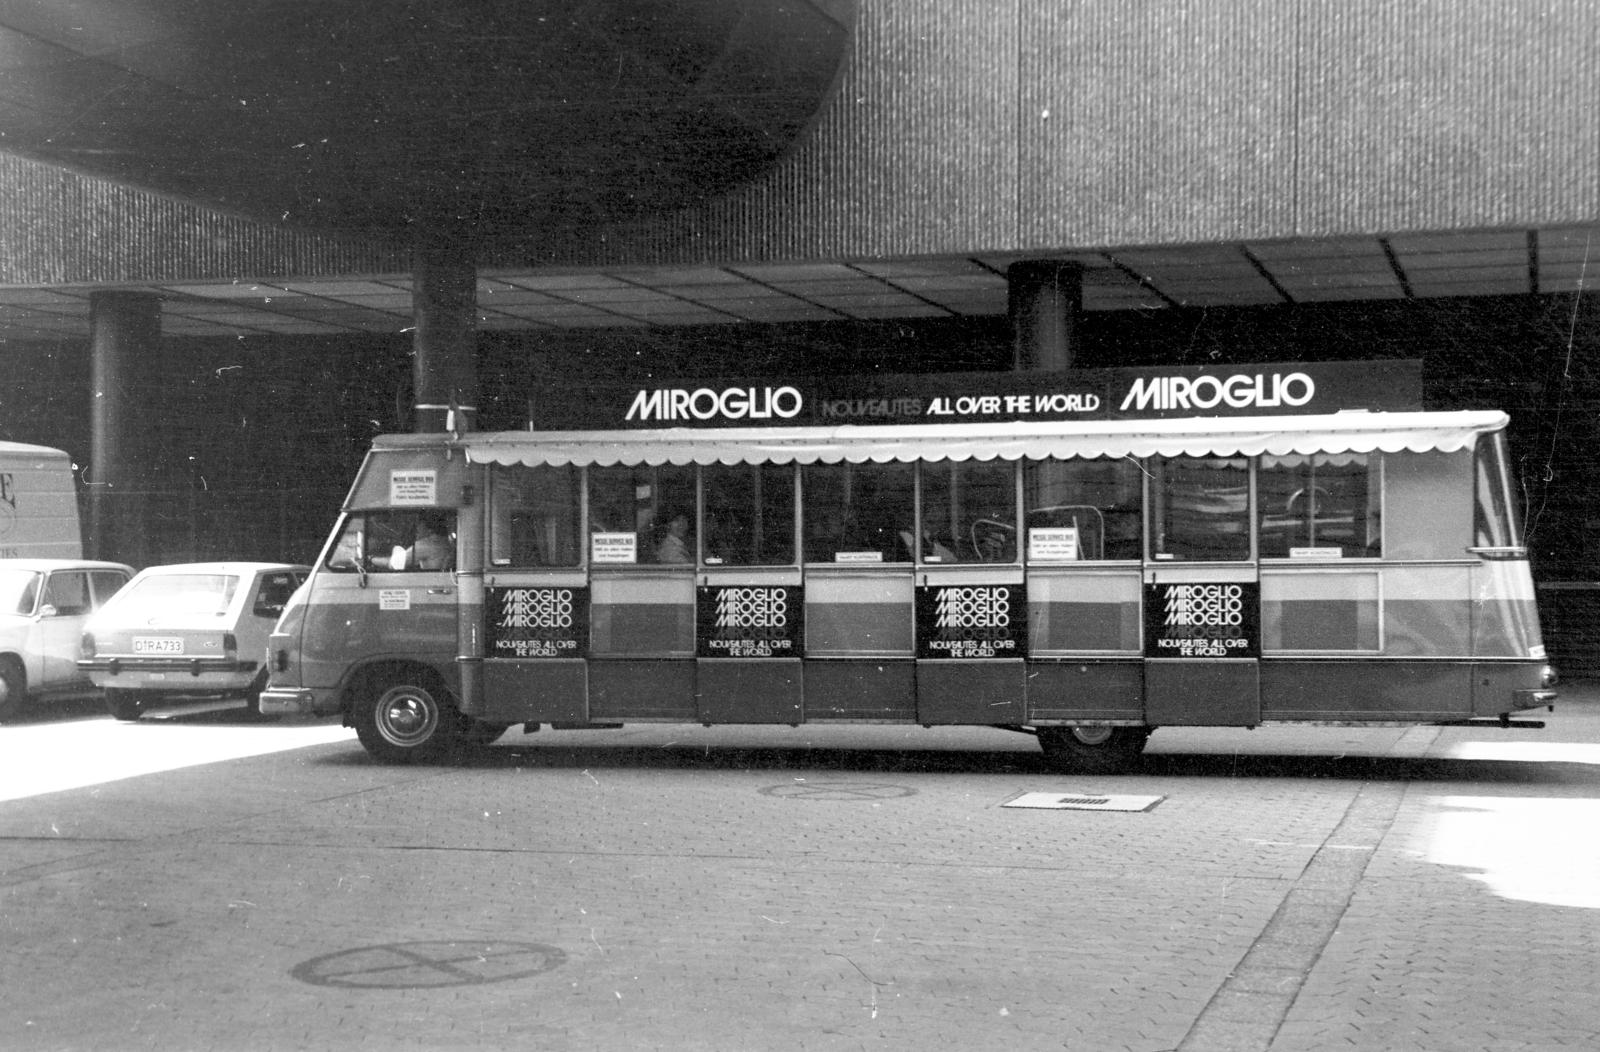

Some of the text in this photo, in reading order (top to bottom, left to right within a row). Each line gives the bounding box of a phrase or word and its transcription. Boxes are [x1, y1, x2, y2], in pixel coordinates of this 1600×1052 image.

[1119, 372, 1315, 411] MIROGLIO
[625, 386, 802, 420] MIROGLIO
[821, 394, 1100, 417] NOUVEAUTES ALL OVER THE WORLD
[502, 589, 572, 602] MIROGLIO
[715, 588, 786, 602] MIROGLIO
[935, 587, 1009, 601] MIROGLIO
[1164, 585, 1242, 599] MIROGLIO
[502, 602, 572, 615] MIROGLIO
[715, 601, 786, 614] MIROGLIO
[935, 601, 1009, 614] MIROGLIO
[1164, 598, 1242, 612] MIROGLIO
[502, 614, 572, 628] MIROGLIO
[715, 614, 786, 627] MIROGLIO
[935, 613, 1009, 627] MIROGLIO
[1164, 611, 1242, 625] MIROGLIO
[496, 640, 577, 649] NOUVEAUTES ALL OVER
[709, 640, 792, 649] NOUVEAUTES ALL OVER
[929, 640, 1015, 649] NOUVEAUTES ALL OVER
[1158, 639, 1248, 648] NOUVEAUTES ALL OVER
[516, 648, 558, 657] THE WORLD
[729, 648, 772, 656] THE WORLD
[950, 648, 995, 657] THE WORLD
[1180, 647, 1227, 656] THE WORLD
